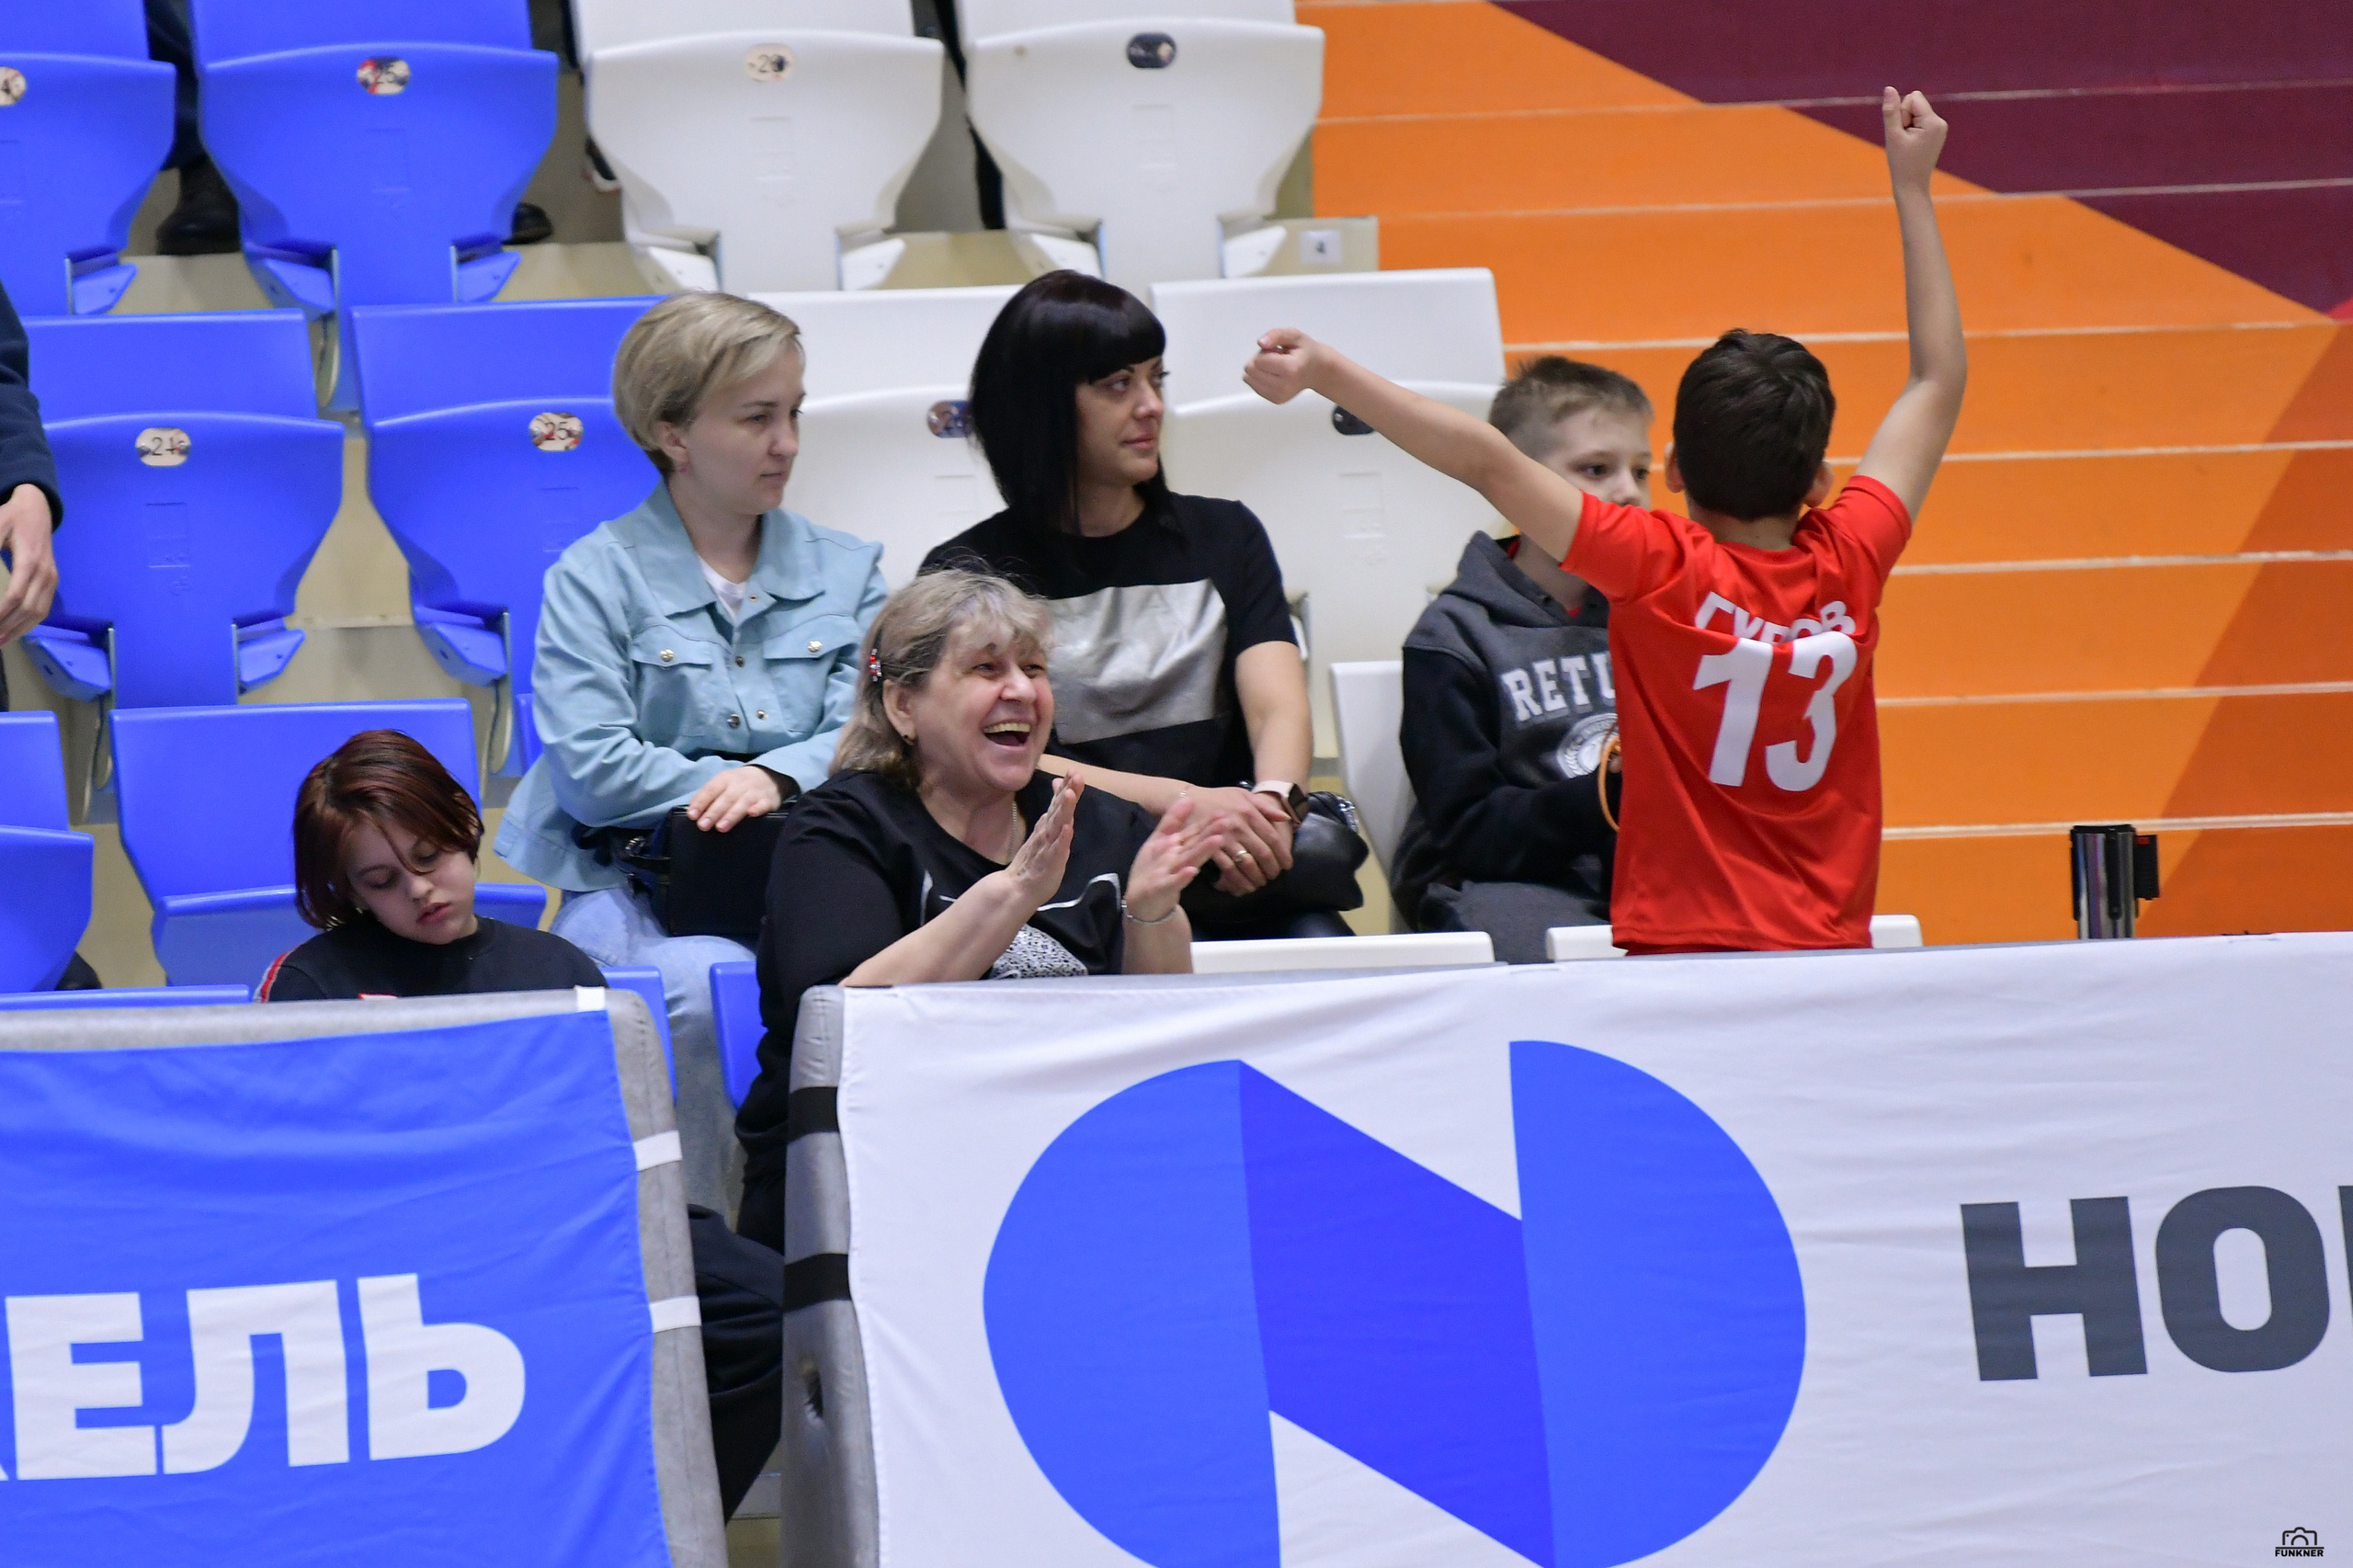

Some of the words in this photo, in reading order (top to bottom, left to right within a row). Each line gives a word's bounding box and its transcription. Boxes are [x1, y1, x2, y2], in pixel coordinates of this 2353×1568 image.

[544, 421, 571, 441] 25
[1693, 631, 1858, 791] 13
[1961, 1185, 2353, 1381] НО
[0, 1273, 525, 1481] ЕЛЬ
